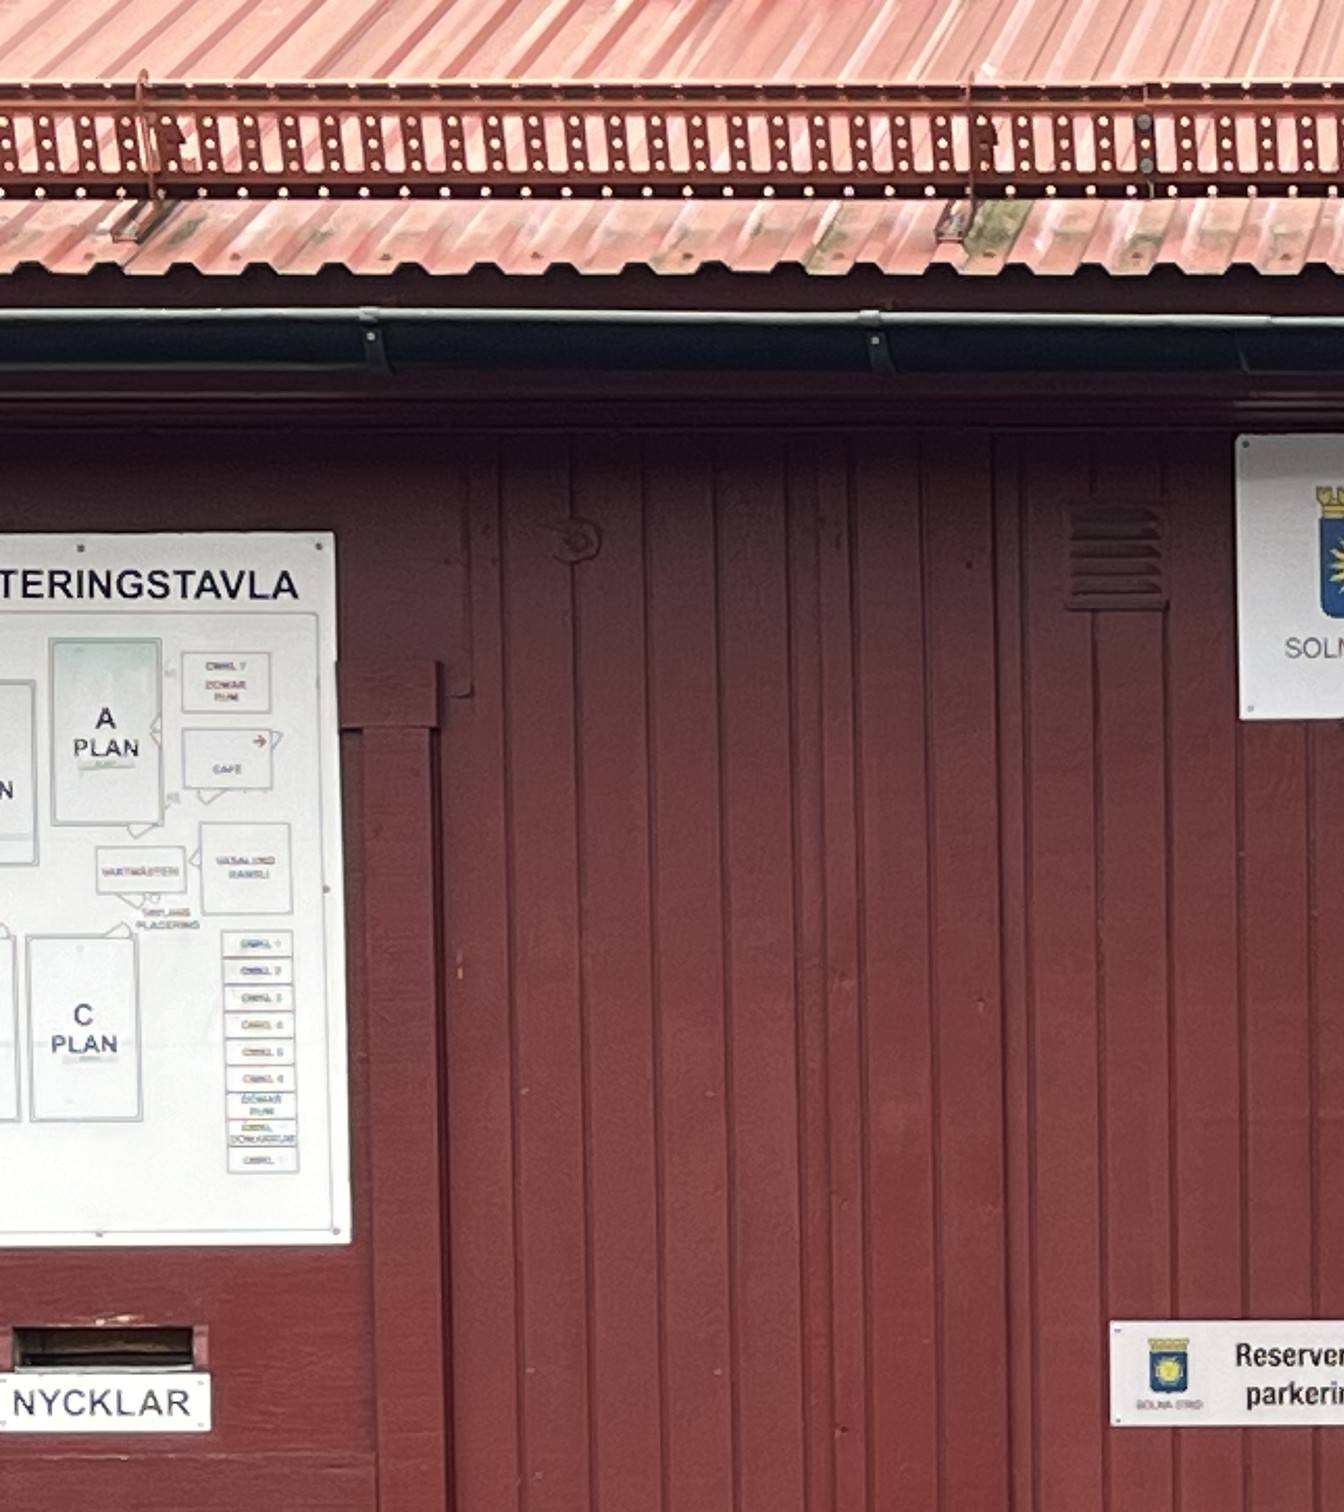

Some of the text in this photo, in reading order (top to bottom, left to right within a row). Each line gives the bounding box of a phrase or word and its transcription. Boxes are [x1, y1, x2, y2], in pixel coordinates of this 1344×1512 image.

[95, 707, 116, 729] A
[74, 739, 139, 757] PLAN
[74, 1003, 93, 1026] C
[52, 1035, 117, 1054] PLAN
[14, 1389, 190, 1416] NYCKLAR
